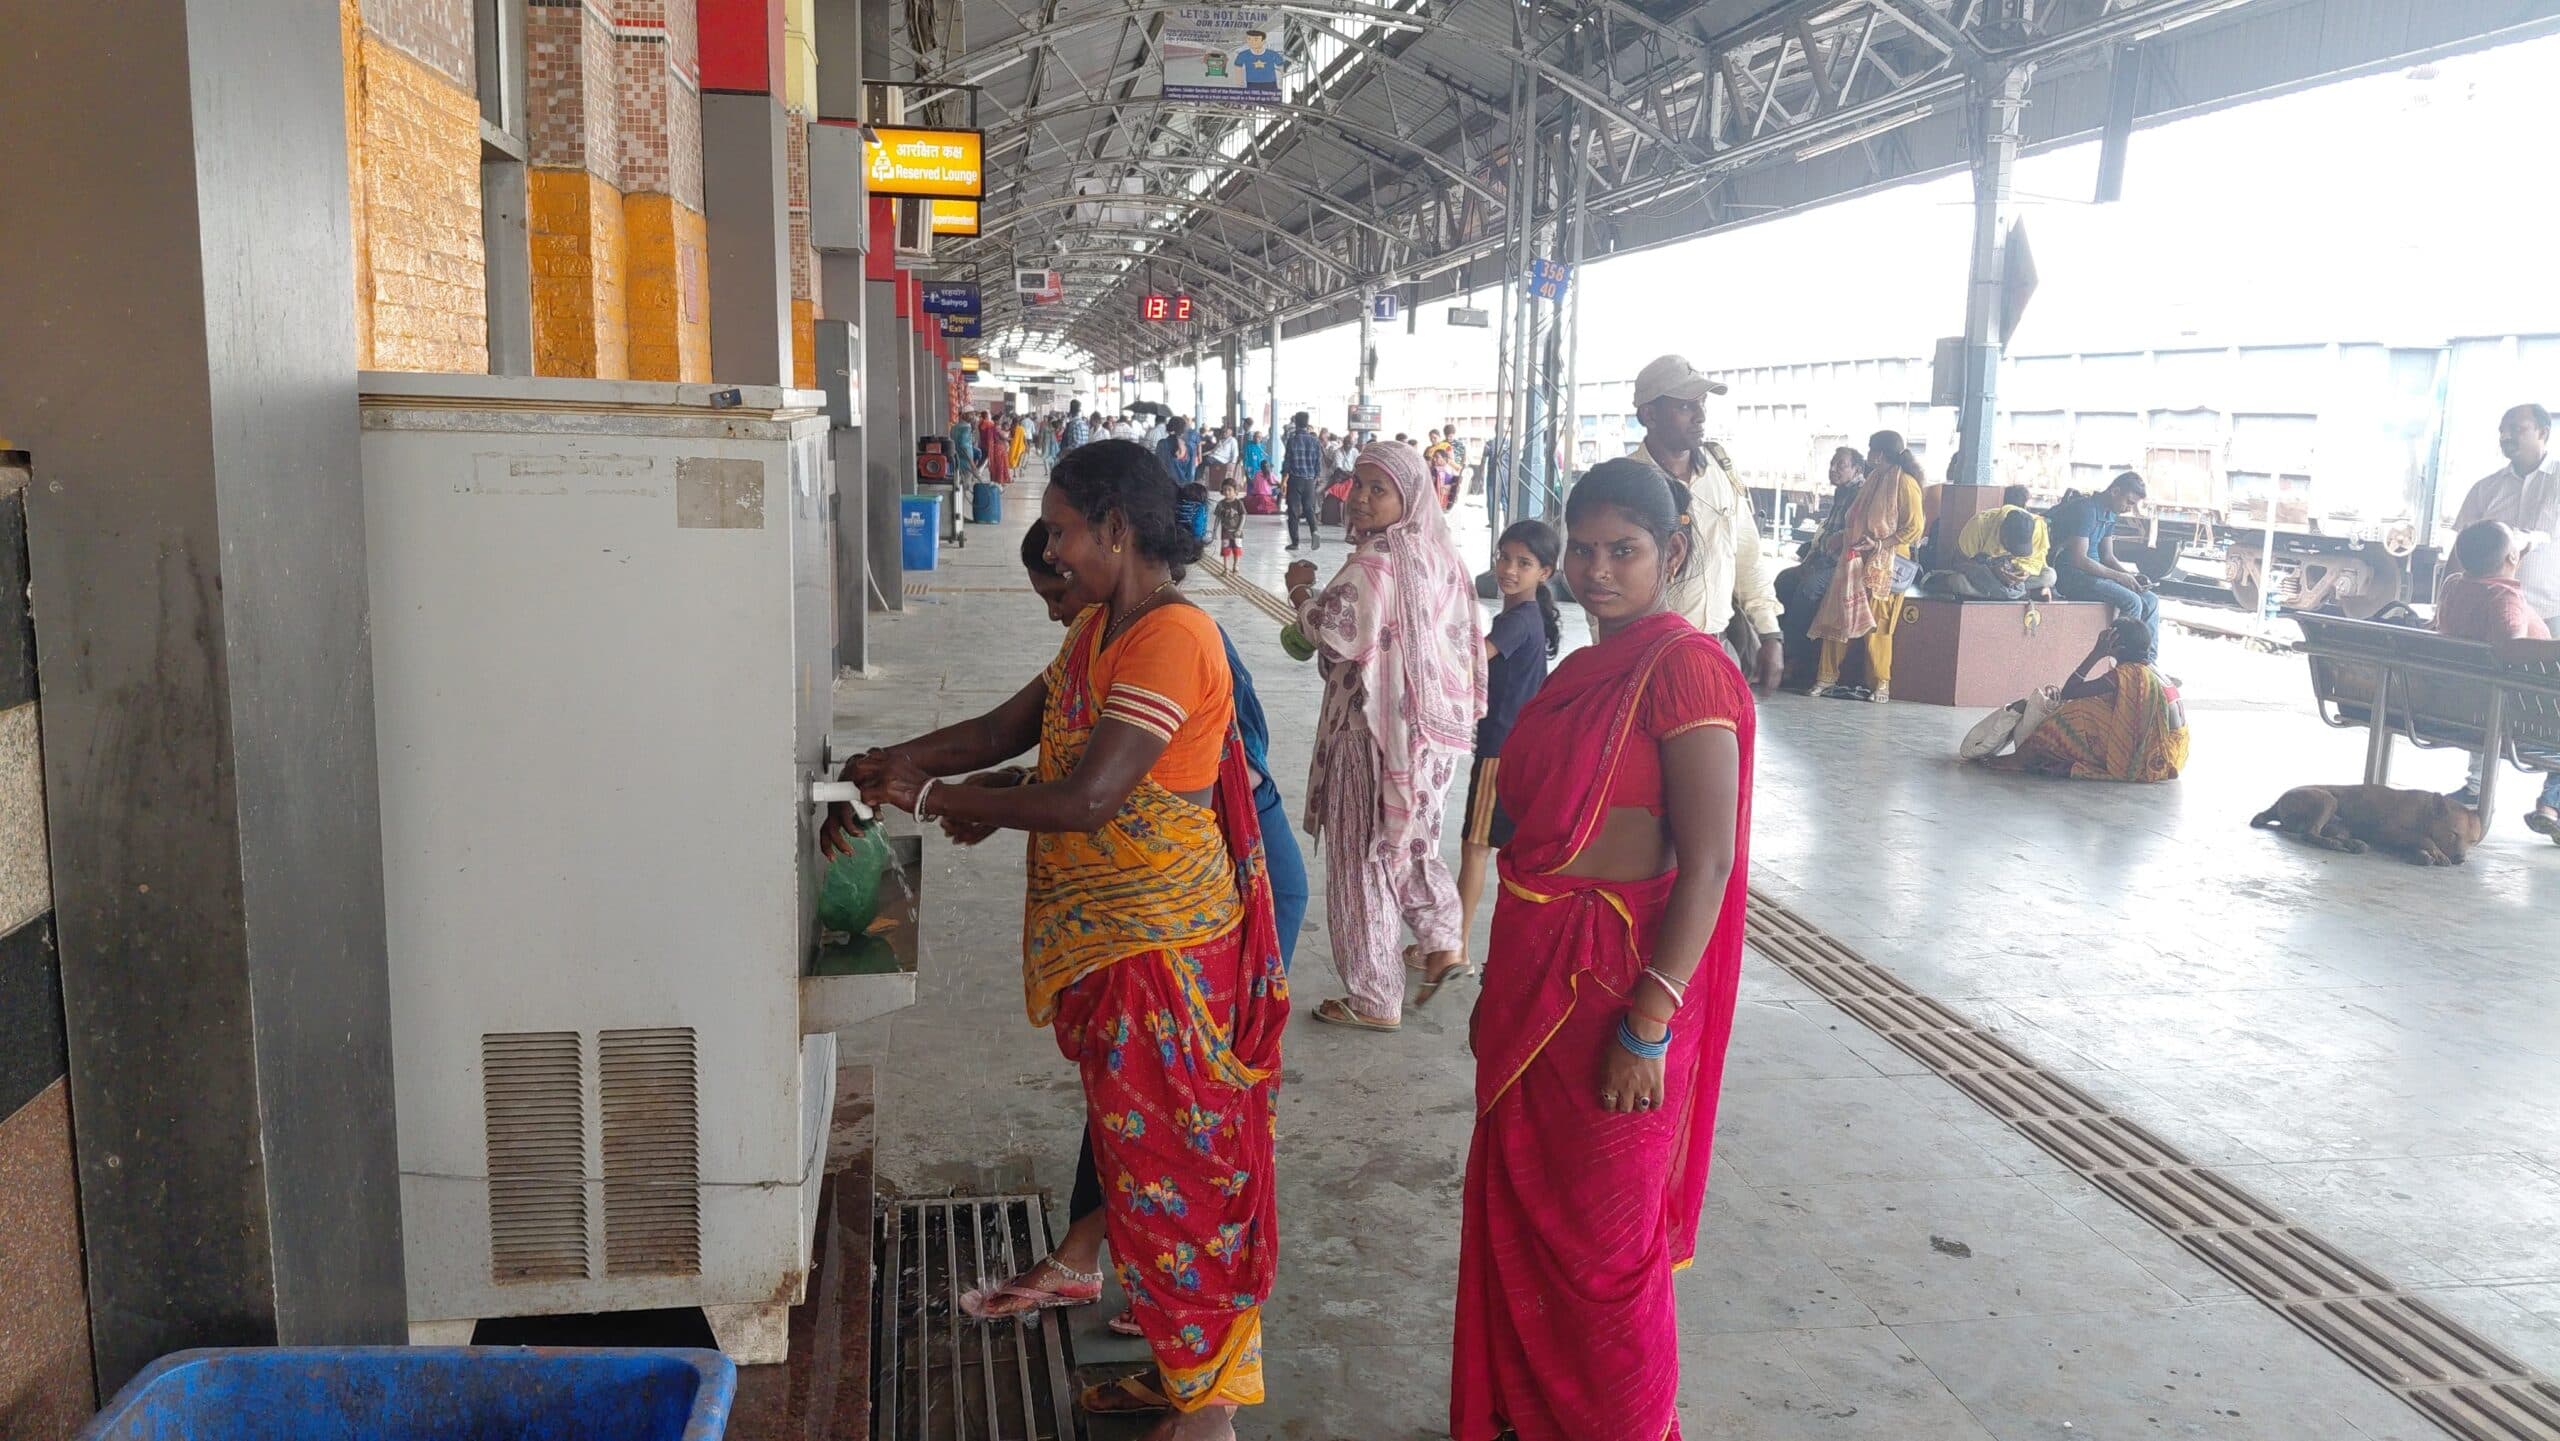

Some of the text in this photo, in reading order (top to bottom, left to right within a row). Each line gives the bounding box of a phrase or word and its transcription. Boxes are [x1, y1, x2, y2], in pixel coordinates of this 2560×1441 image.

[1180, 9, 1268, 21] LET'S NOT STAIN
[1196, 20, 1254, 29] OUR STATIONS
[896, 140, 963, 159] आरक्षित कक्ष
[895, 164, 977, 185] Reserved Lounge
[1540, 261, 1565, 281] 358
[1540, 281, 1556, 298] 40
[941, 299, 968, 308] Sahyog
[1381, 298, 1390, 316] 1
[949, 325, 964, 333] Exit
